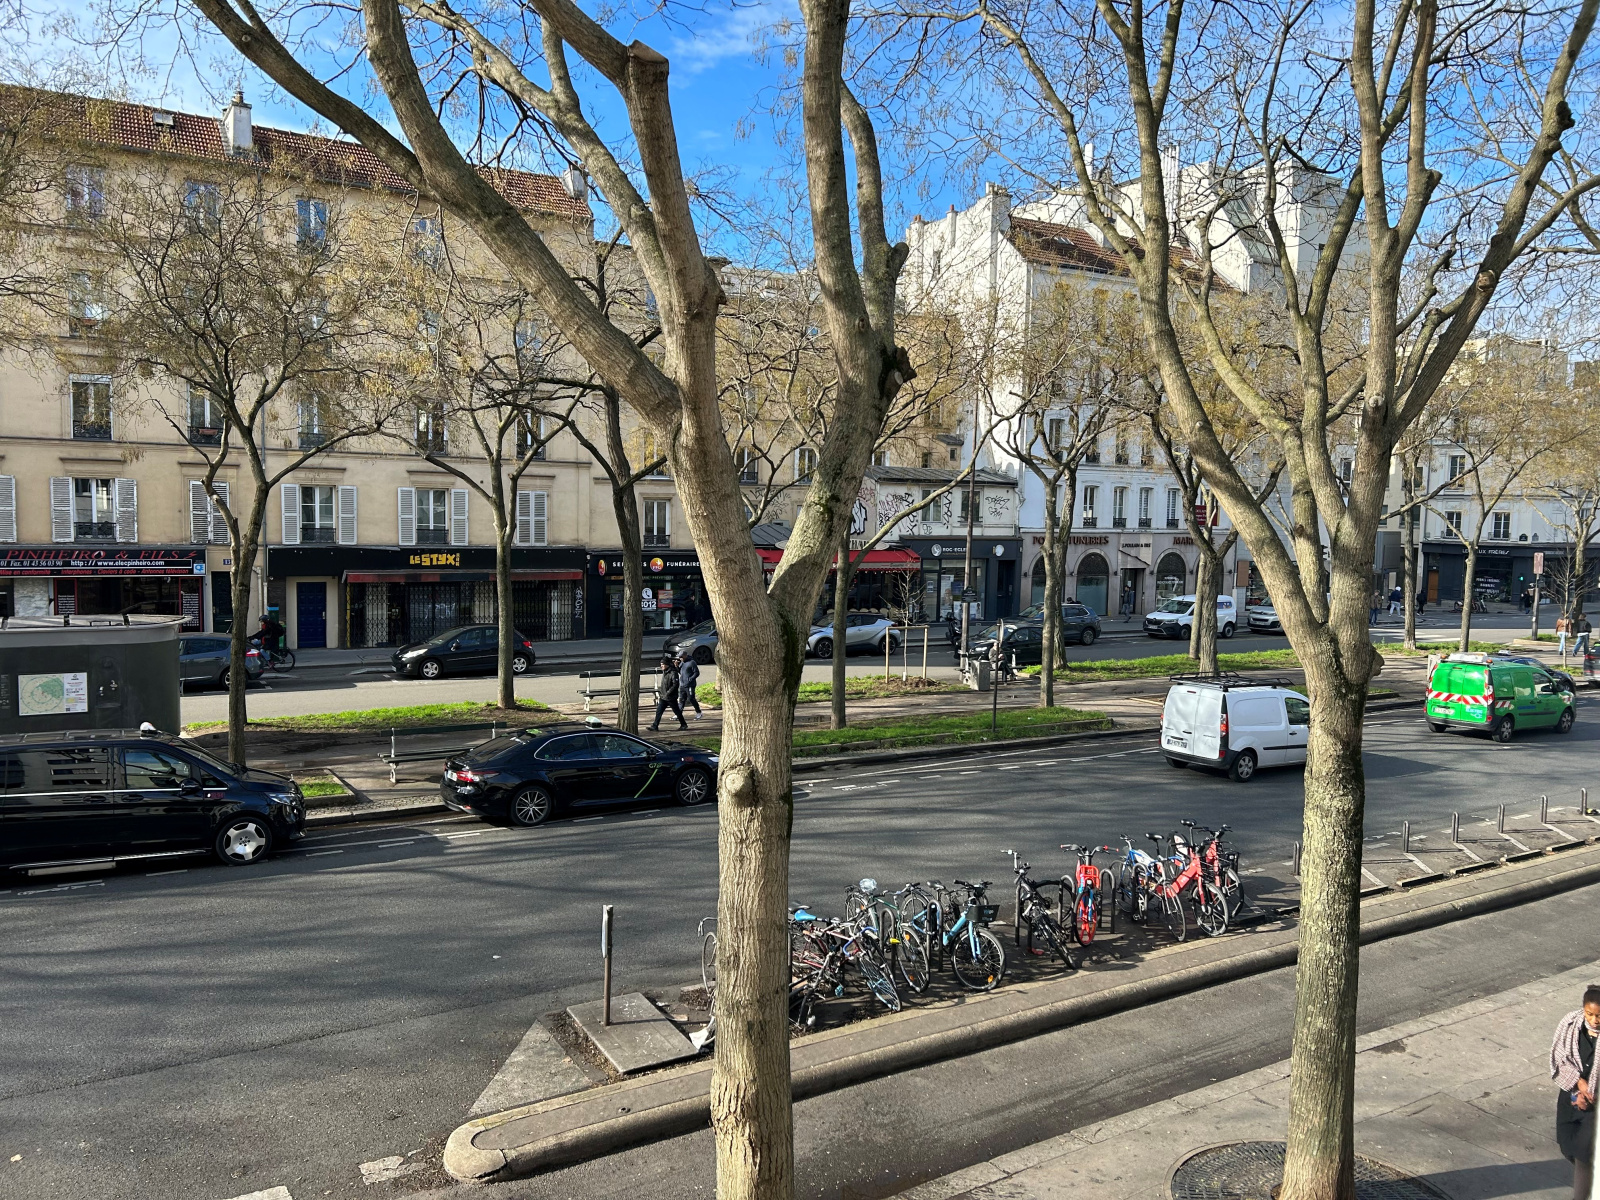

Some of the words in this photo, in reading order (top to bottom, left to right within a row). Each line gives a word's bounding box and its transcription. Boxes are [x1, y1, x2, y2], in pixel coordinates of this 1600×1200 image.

[6, 550, 107, 559] PINHEIRO
[115, 550, 129, 559] &
[140, 550, 180, 559] FILS
[410, 555, 420, 564] LE
[421, 553, 456, 566] STYX
